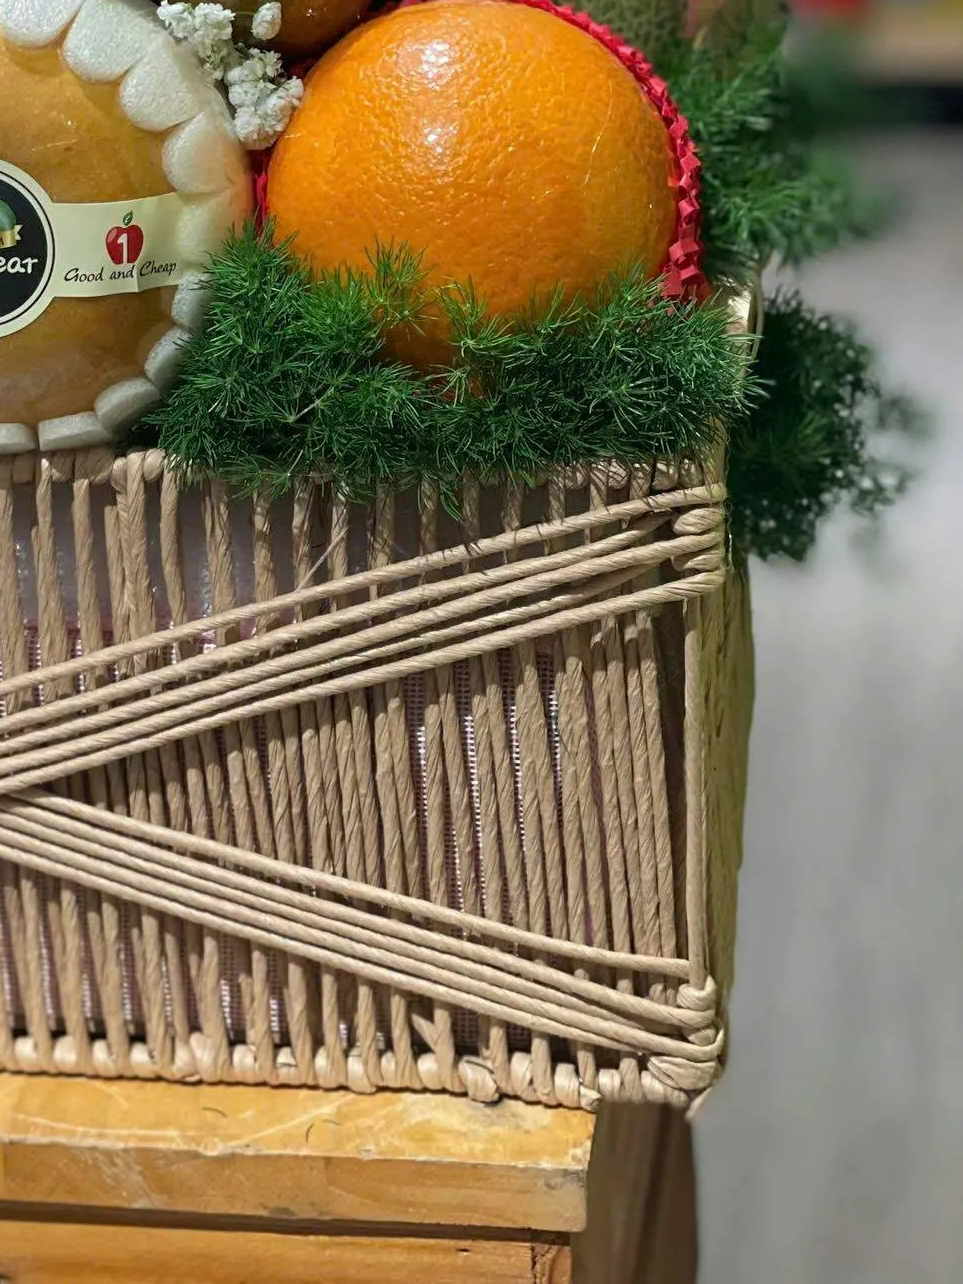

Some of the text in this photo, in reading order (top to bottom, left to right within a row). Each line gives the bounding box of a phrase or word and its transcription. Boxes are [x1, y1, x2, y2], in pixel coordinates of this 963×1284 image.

[64, 260, 177, 282] Good and Cheap
